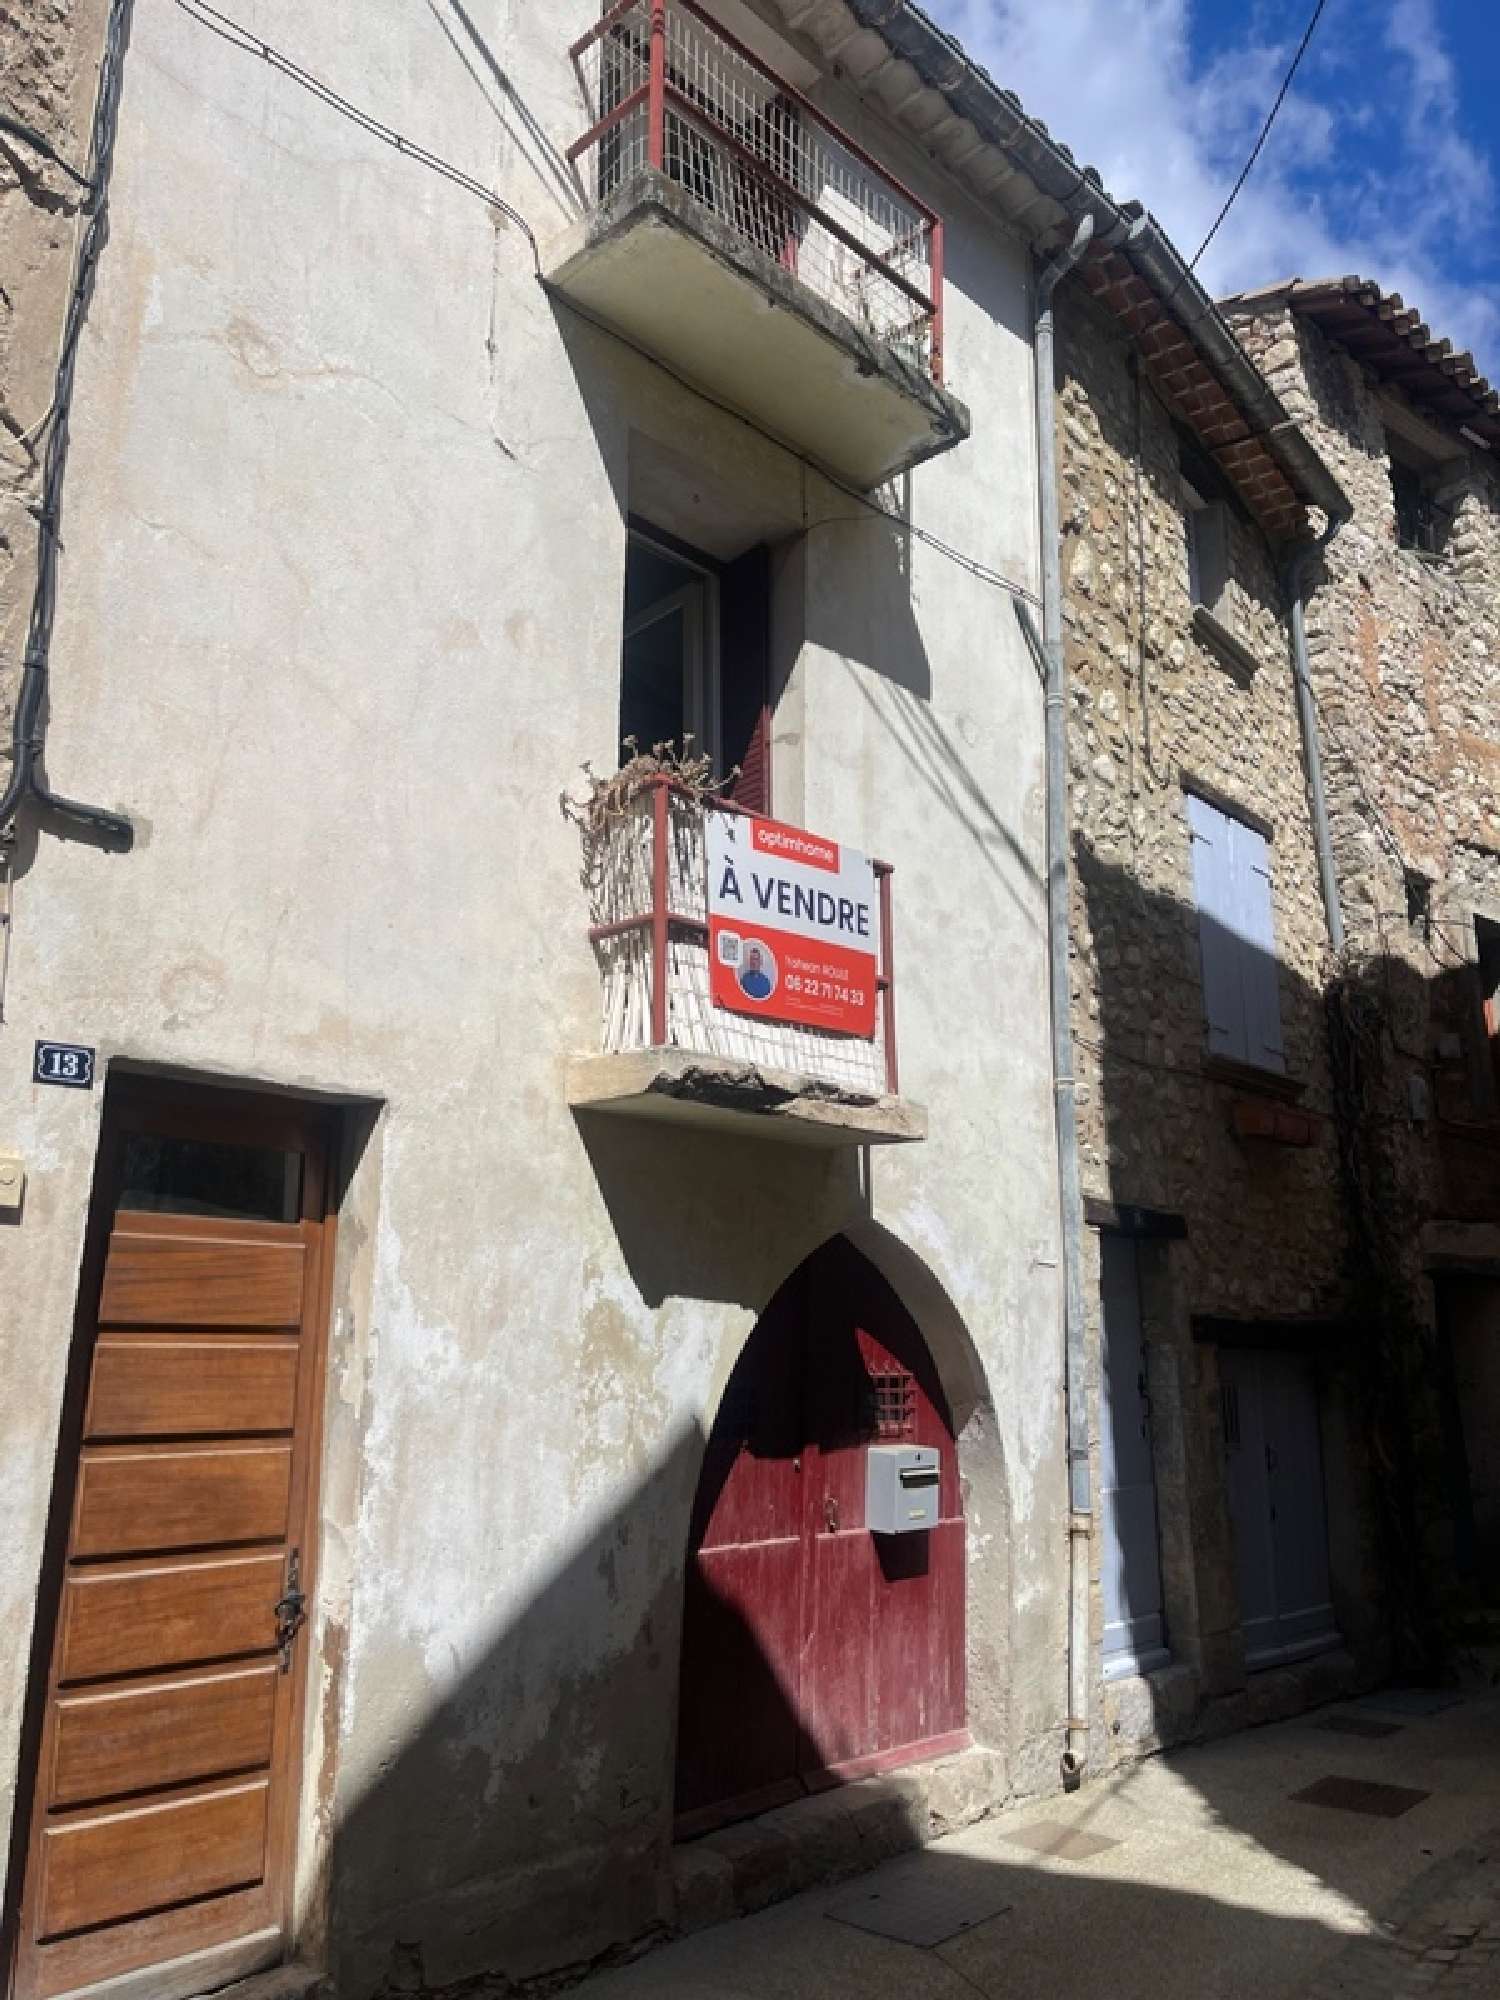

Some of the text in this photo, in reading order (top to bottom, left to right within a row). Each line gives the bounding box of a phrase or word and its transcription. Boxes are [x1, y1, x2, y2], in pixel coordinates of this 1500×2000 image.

[758, 829, 834, 864] optimhome
[719, 854, 870, 936] À VENDRE
[49, 1053, 79, 1076] 13
